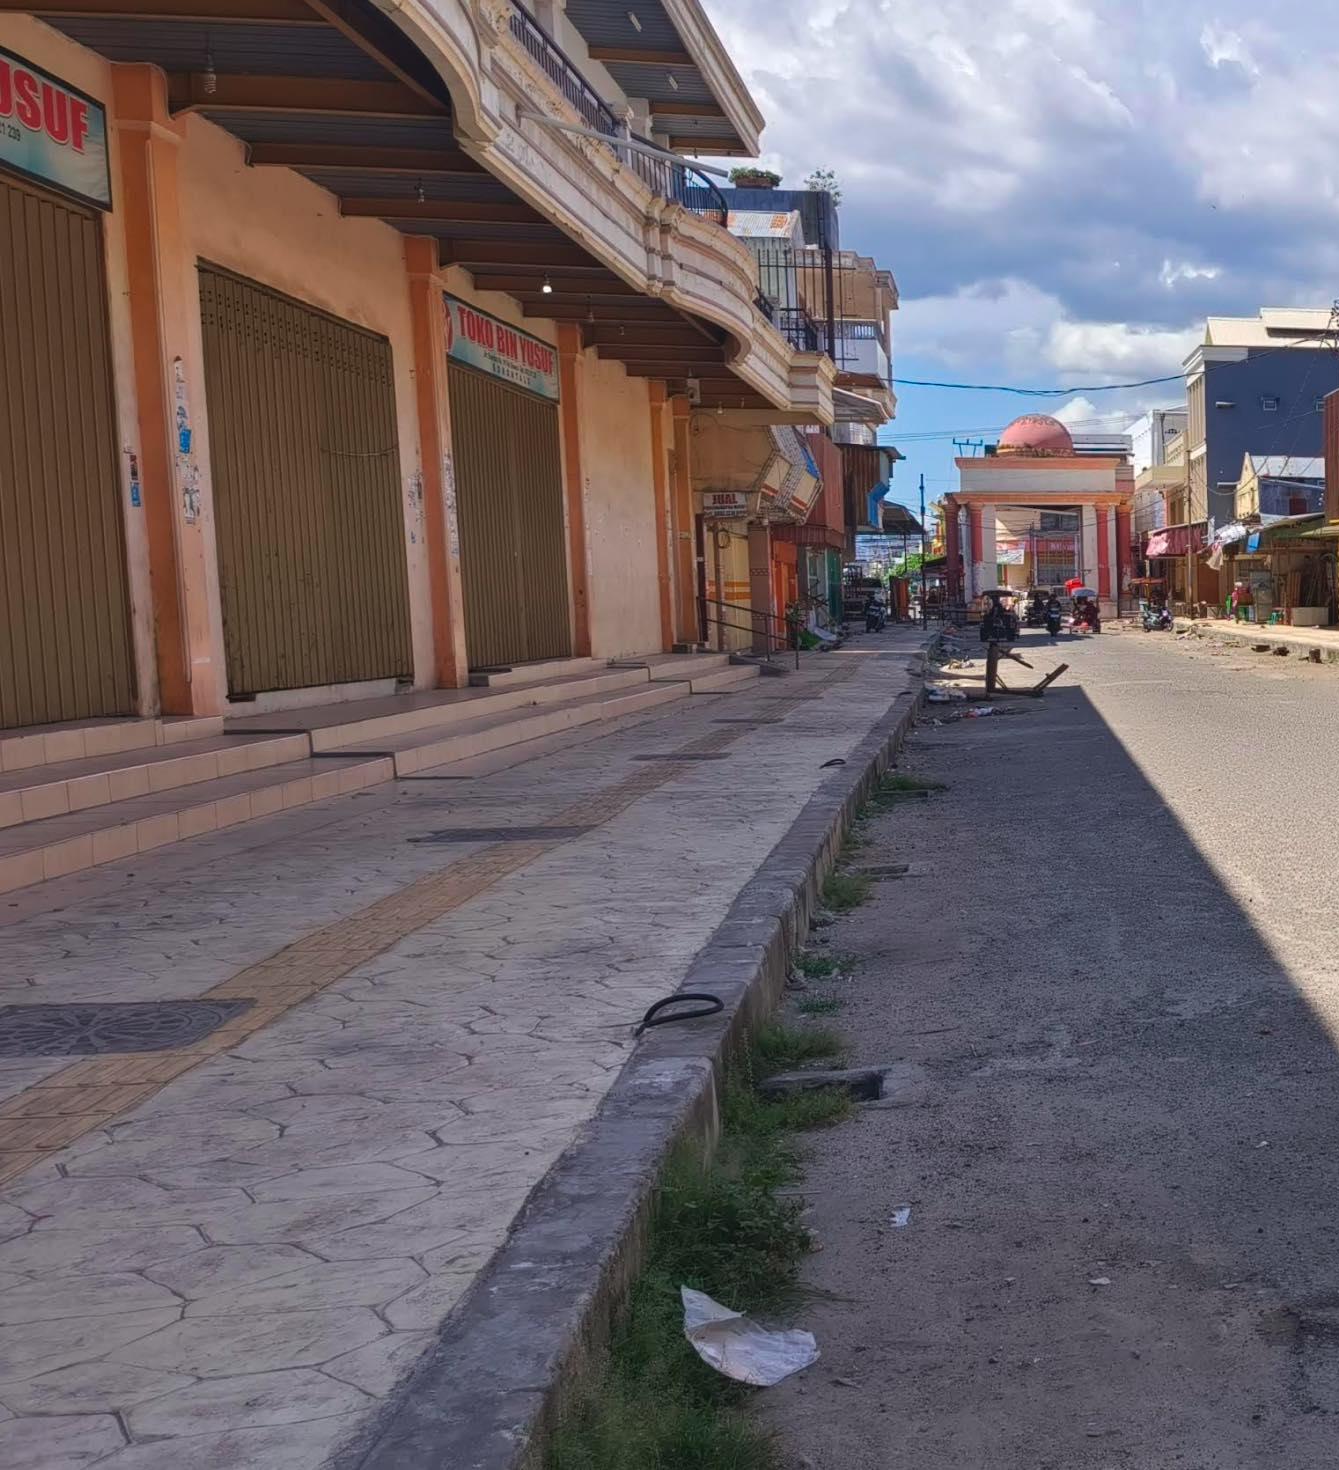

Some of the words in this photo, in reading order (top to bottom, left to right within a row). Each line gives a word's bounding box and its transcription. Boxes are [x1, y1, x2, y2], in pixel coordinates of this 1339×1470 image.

[457, 305, 494, 350] TOKO
[496, 324, 518, 360] BIN
[519, 336, 554, 377] YUSUF
[712, 493, 738, 505] JUAL
